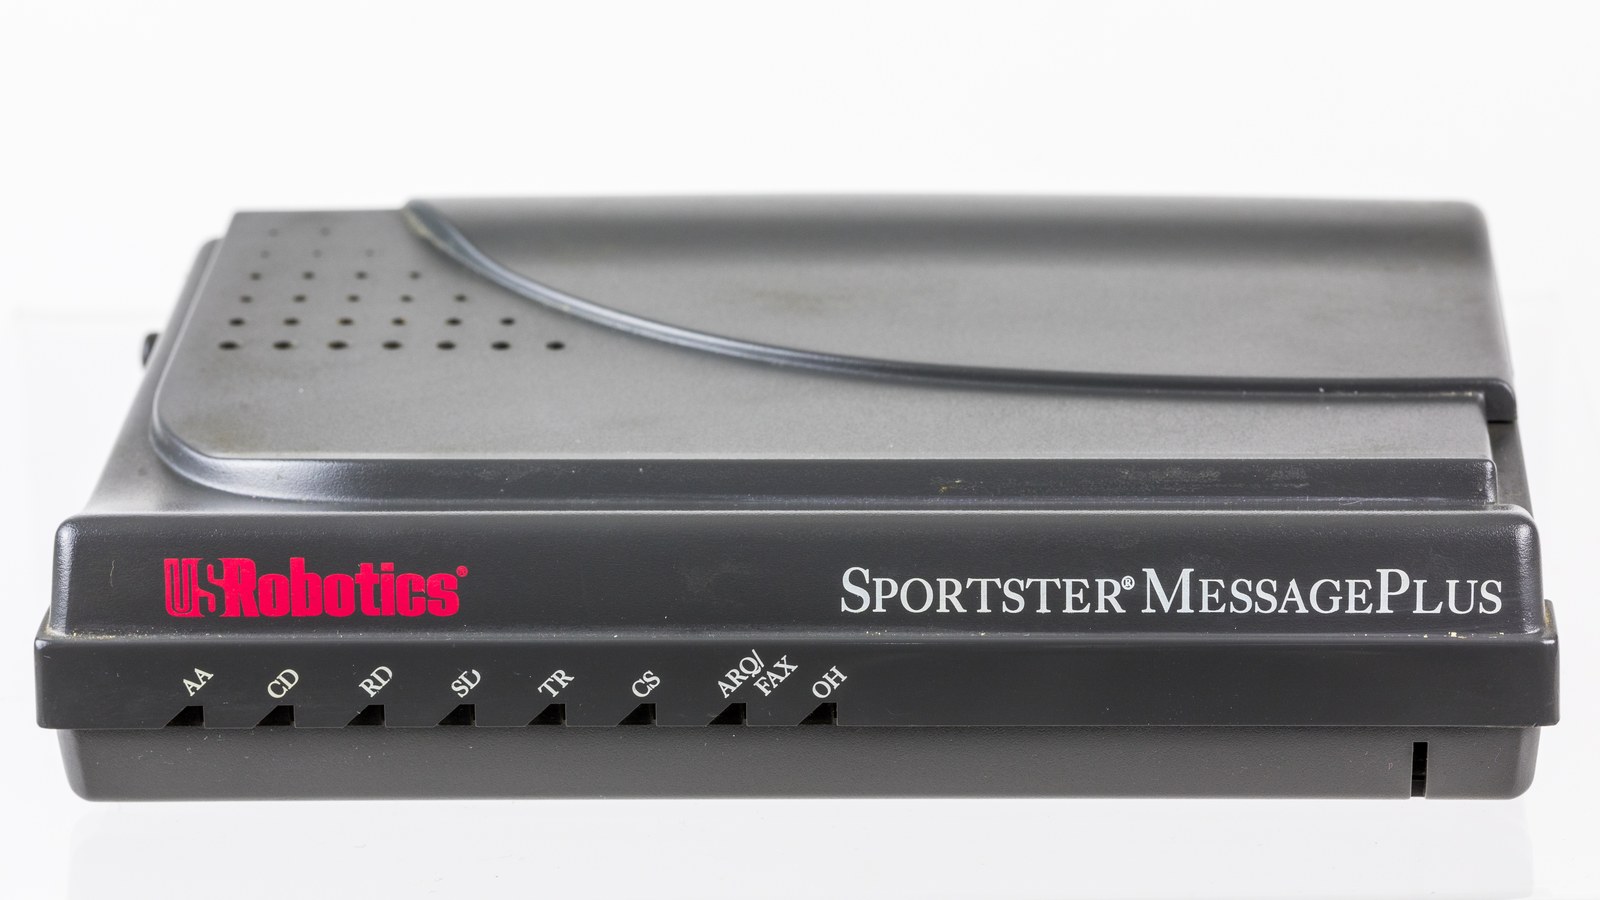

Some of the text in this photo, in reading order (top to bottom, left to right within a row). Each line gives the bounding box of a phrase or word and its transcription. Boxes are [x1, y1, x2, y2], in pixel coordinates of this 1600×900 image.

[1141, 567, 1504, 616] MESSAGEPLUS
[181, 666, 215, 697] AA
[266, 667, 300, 699] CD
[358, 665, 394, 698] RD
[537, 668, 575, 699] TR
[631, 669, 662, 699] CS
[752, 654, 799, 697] FAX
[811, 665, 849, 700] OH
